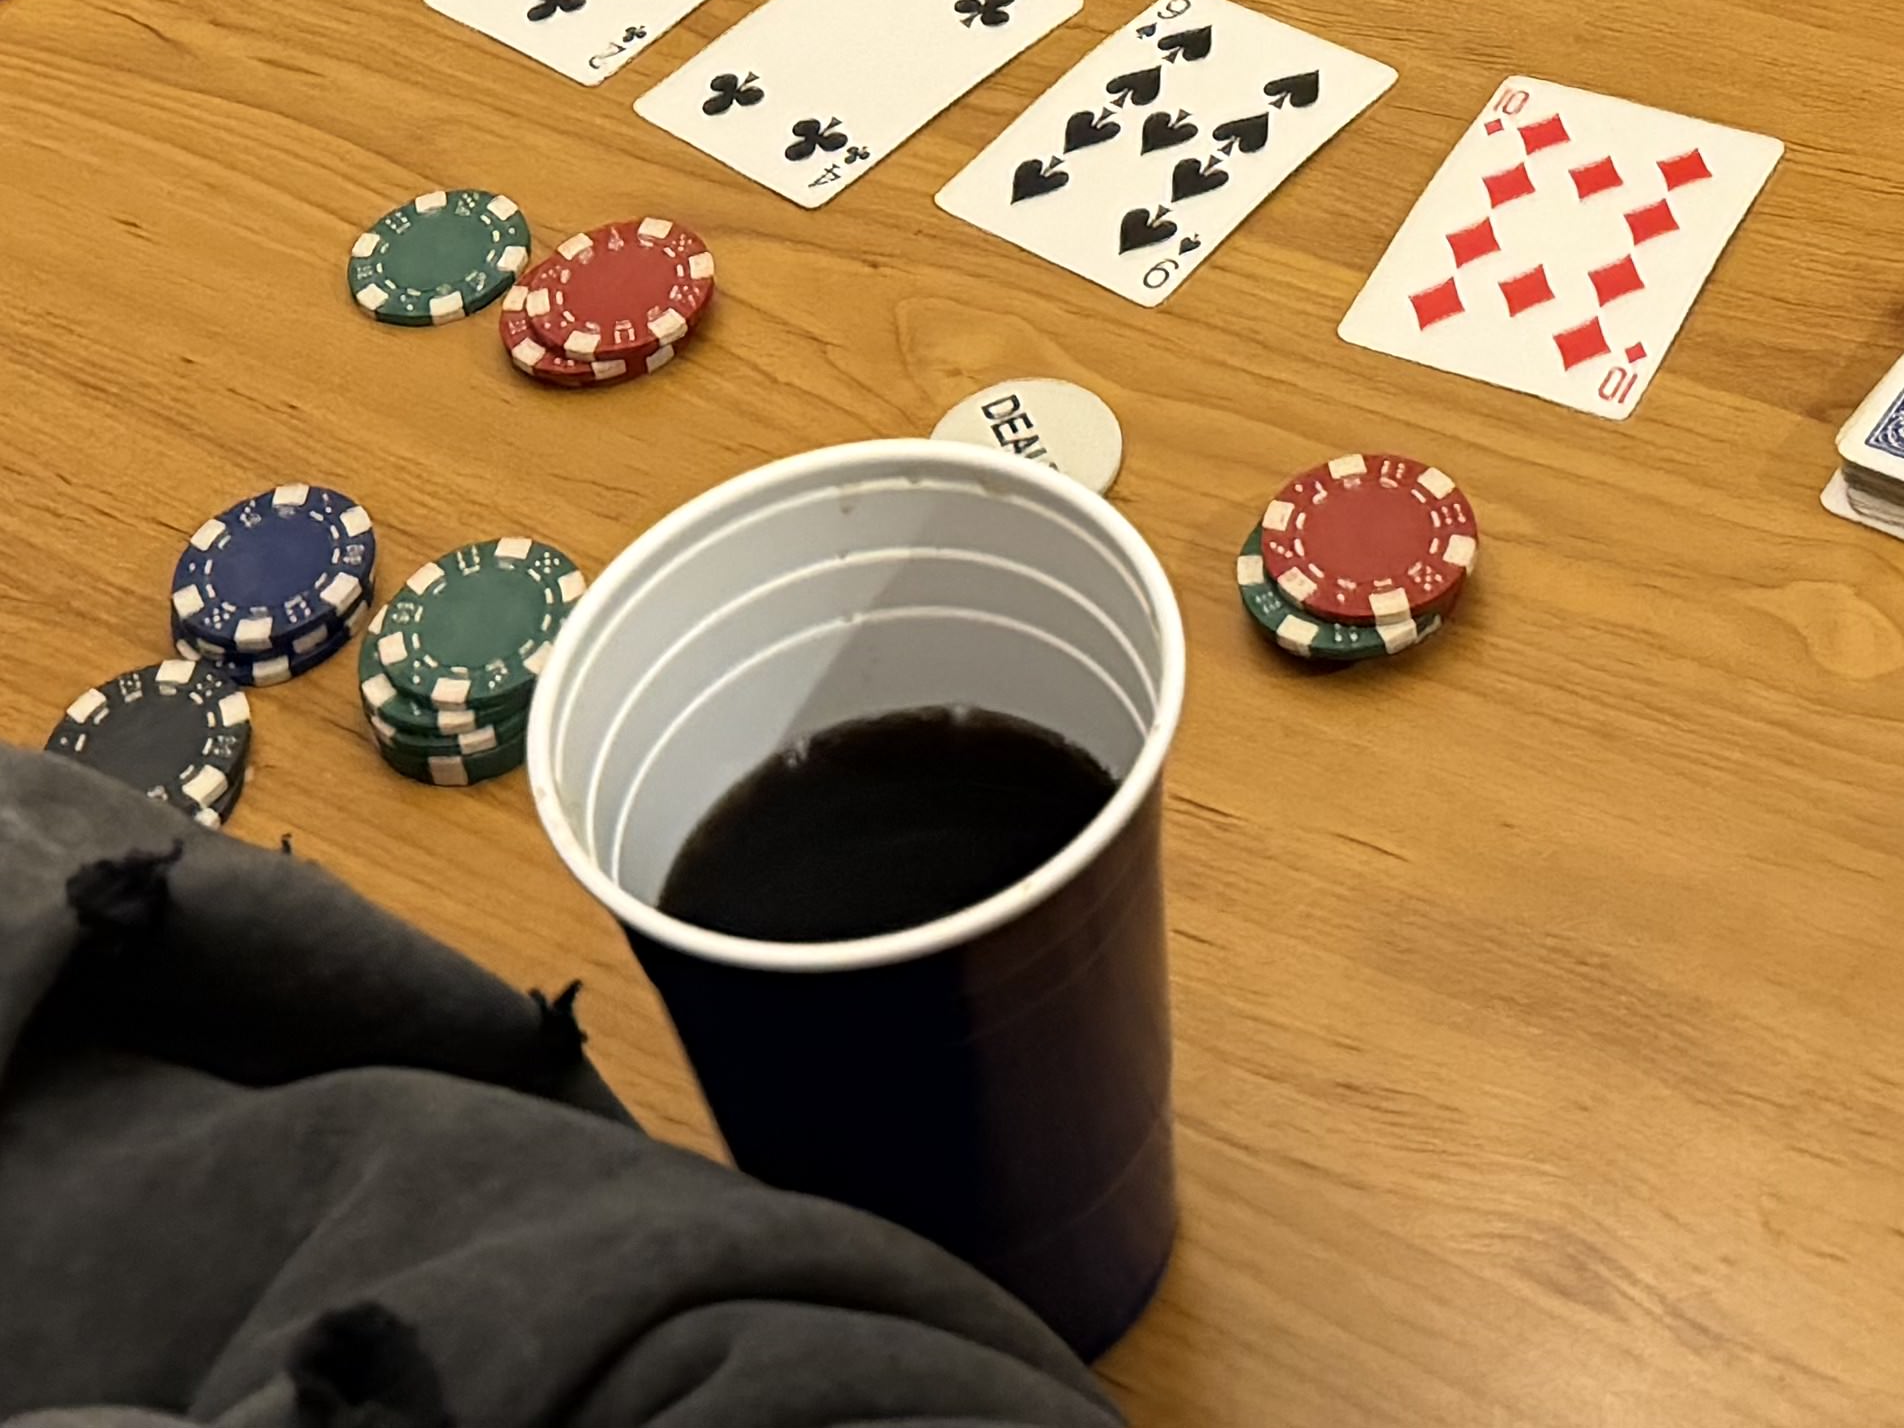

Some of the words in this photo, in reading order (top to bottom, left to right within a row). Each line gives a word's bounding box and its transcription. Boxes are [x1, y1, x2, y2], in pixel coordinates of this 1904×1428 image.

[589, 41, 627, 70] 2
[1493, 89, 1529, 115] 10
[808, 163, 841, 188] 4
[1598, 366, 1638, 404] 10
[981, 394, 1058, 472] DEA
